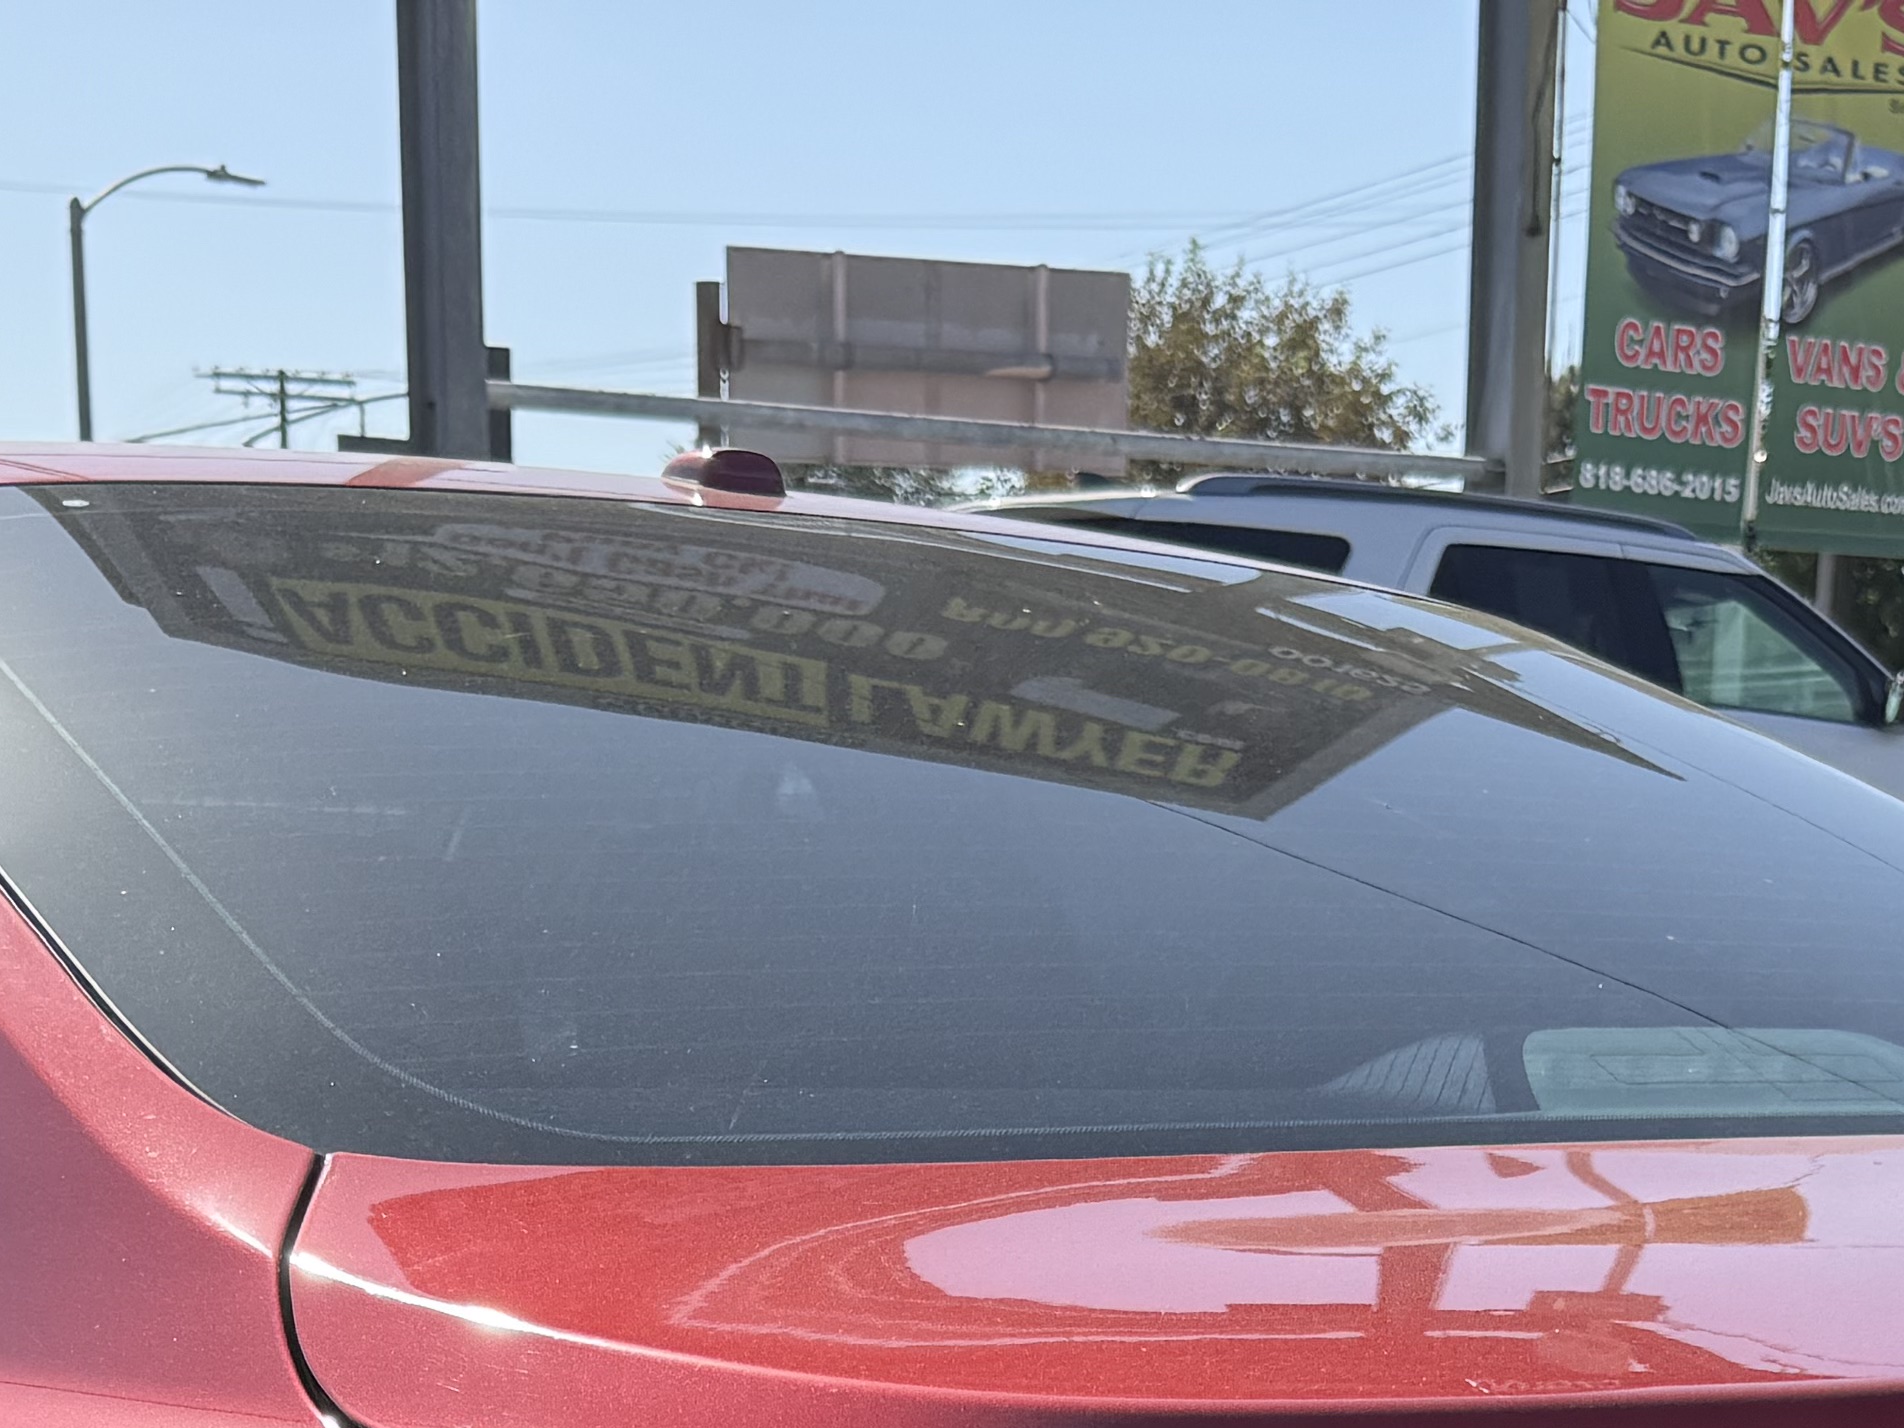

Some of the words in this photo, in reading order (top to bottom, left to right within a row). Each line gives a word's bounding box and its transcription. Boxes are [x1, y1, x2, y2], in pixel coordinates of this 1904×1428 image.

[1651, 30, 1767, 64] AUTO
[1615, 316, 1724, 377] CARS
[1786, 334, 1889, 393] VANS
[1585, 386, 1745, 449] TRUCKS
[1579, 461, 1741, 503] 818-686-2015
